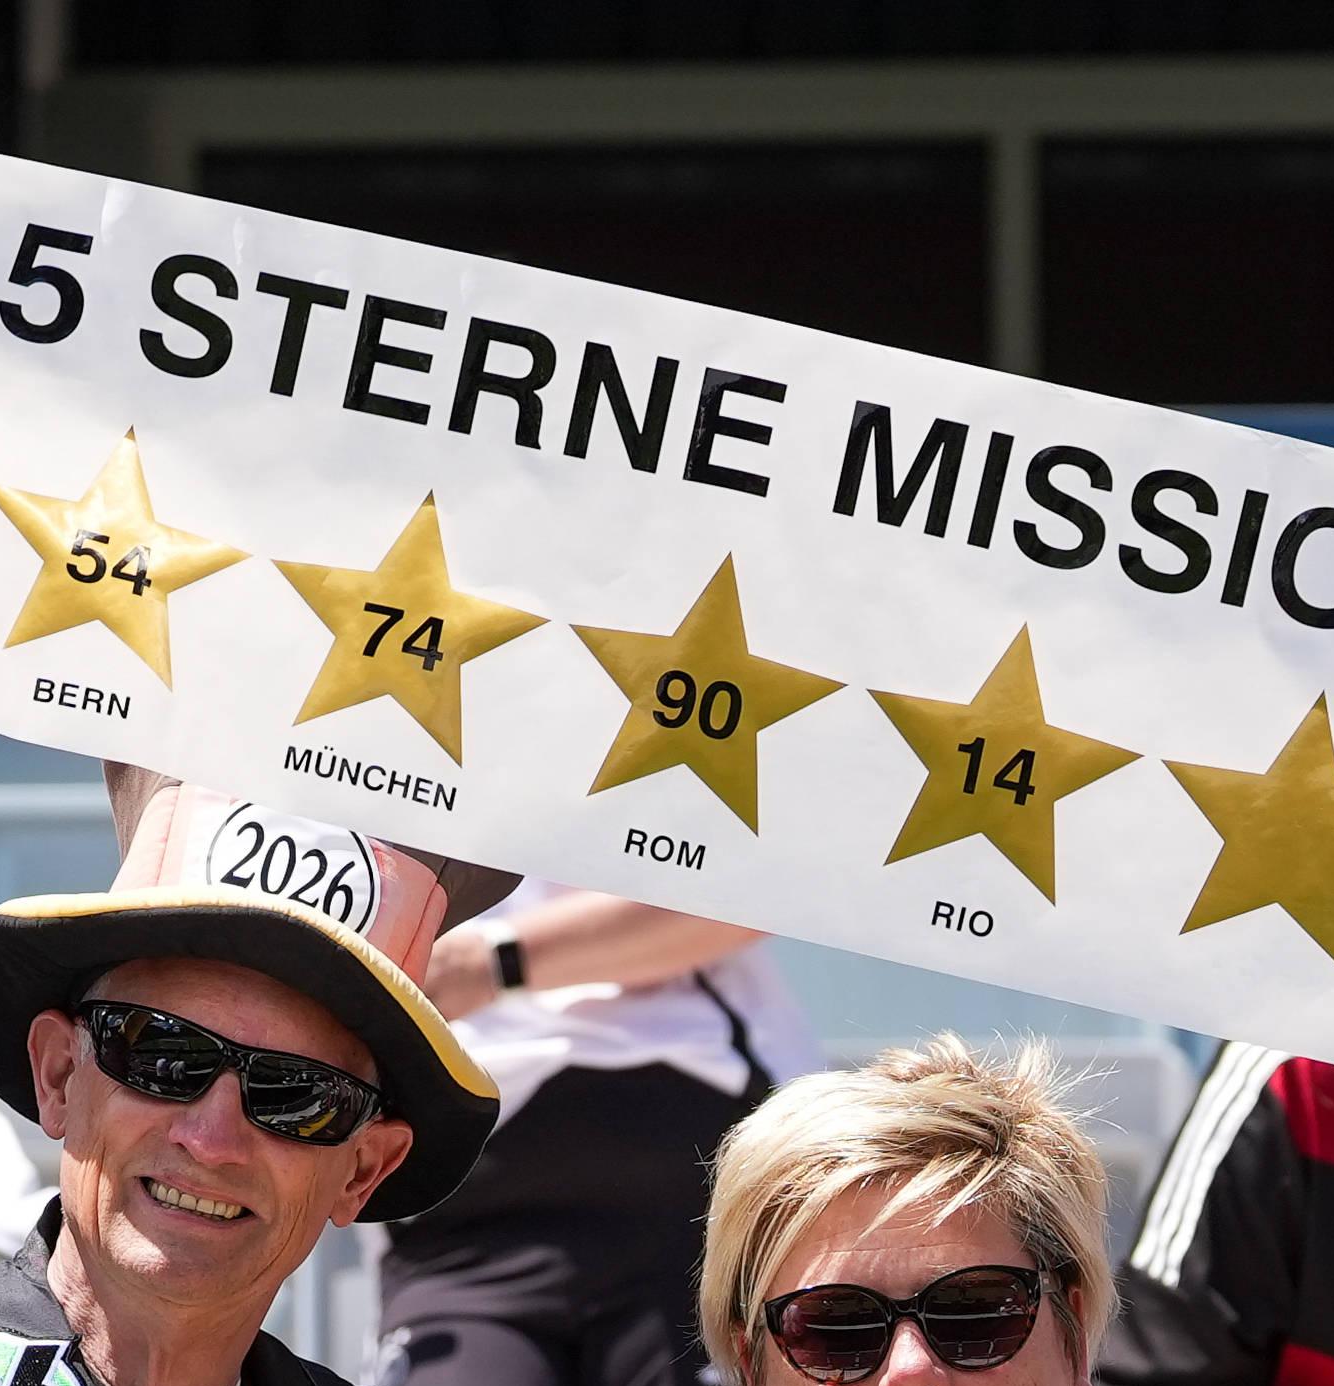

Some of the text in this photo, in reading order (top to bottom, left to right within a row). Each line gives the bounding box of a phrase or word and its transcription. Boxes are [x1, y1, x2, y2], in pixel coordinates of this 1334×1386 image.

[138, 253, 791, 499] STERNE
[65, 529, 153, 597] 54
[361, 601, 445, 673] 74
[32, 677, 132, 720] BERN
[651, 668, 744, 742] 90
[283, 744, 458, 812] MÜNCHEN
[956, 735, 1037, 808] 14
[219, 819, 357, 925] 2026
[623, 827, 707, 871] ROM
[930, 900, 995, 938] RIO
